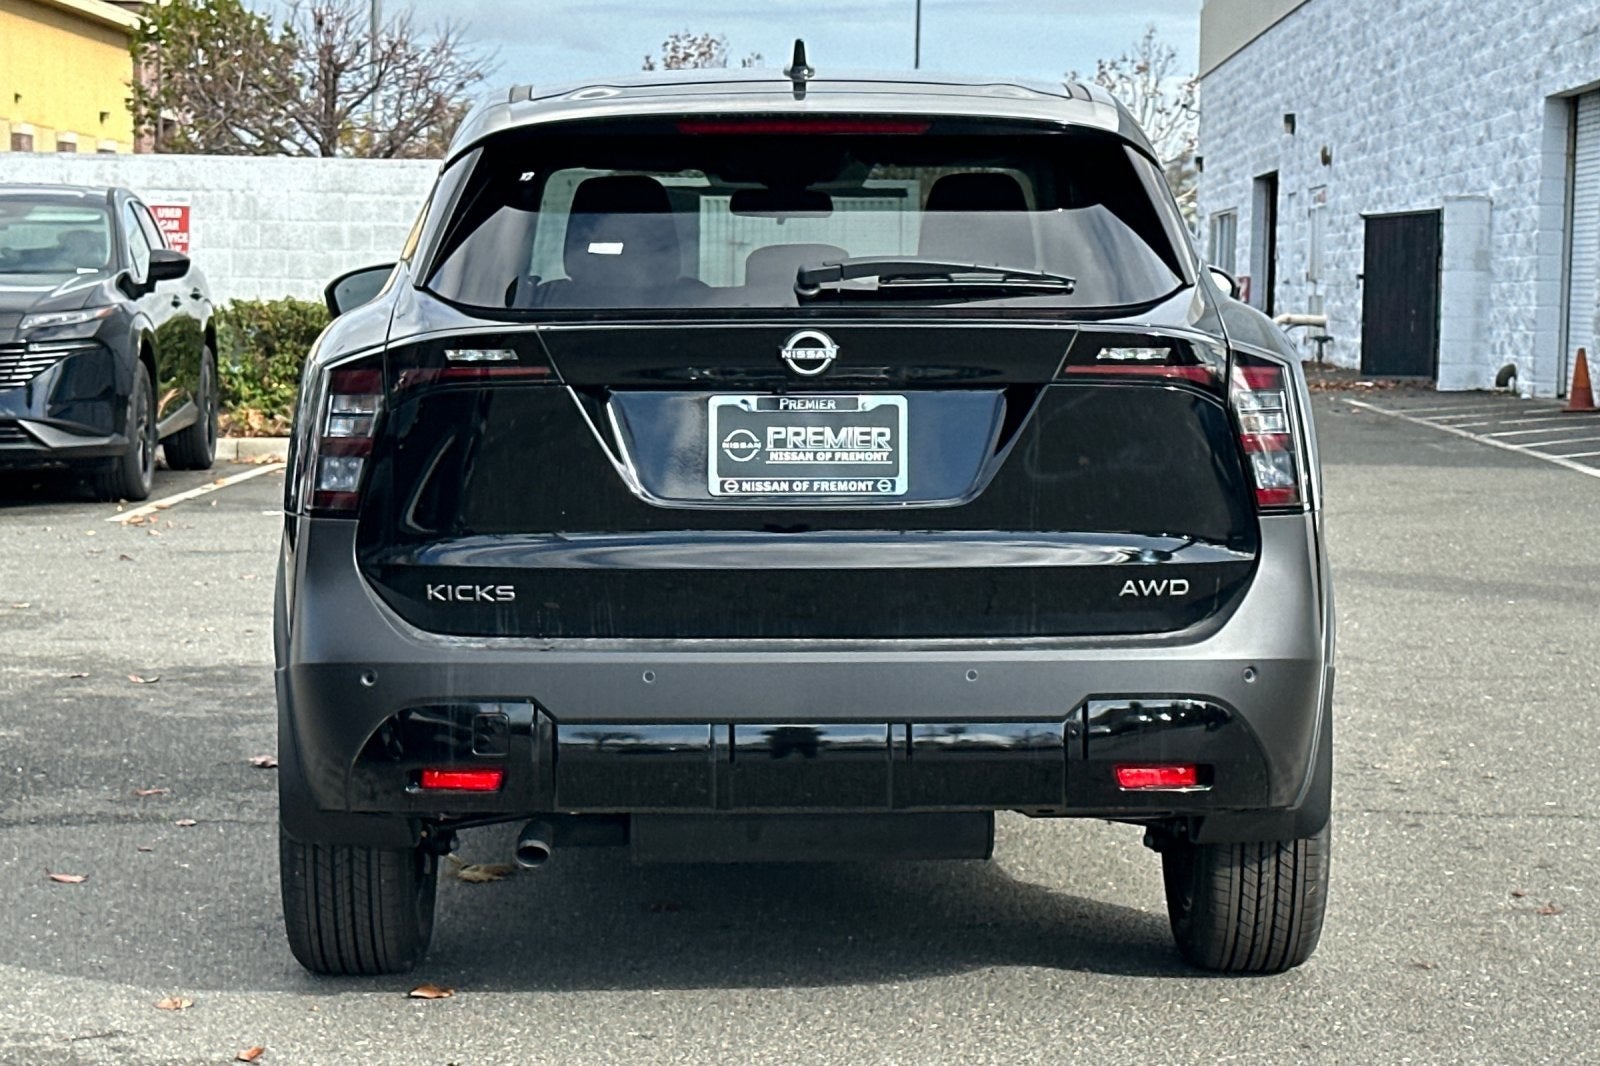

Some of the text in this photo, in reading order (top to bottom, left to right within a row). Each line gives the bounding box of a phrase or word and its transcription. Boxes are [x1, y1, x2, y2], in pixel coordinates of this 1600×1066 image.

[781, 349, 837, 359] NISSAN
[779, 398, 837, 410] PREMIER
[766, 426, 891, 448] PREMIER
[769, 451, 890, 462] NISSAN OF FREMONT
[741, 480, 873, 491] NISSAN OF FREMONT
[426, 584, 516, 602] KICKS
[1118, 579, 1190, 597] AWD
